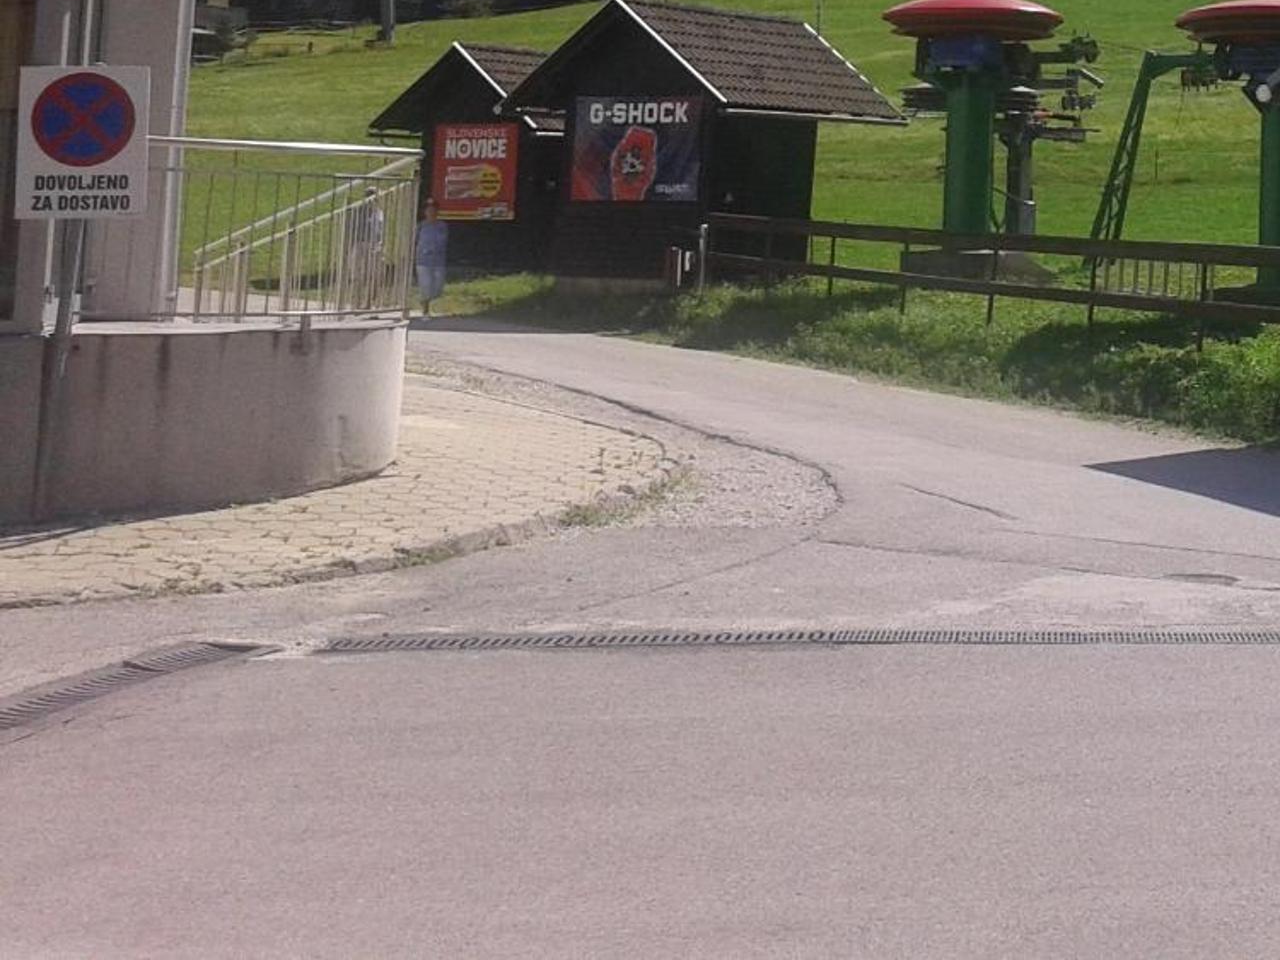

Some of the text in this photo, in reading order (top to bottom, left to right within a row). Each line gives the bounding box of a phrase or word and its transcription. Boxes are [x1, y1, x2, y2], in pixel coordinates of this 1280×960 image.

[589, 102, 688, 124] G-SHOCK
[445, 138, 508, 159] NOVICE
[34, 175, 129, 191] DOVOLJENO
[31, 195, 131, 211] ZA DOSTAVO
